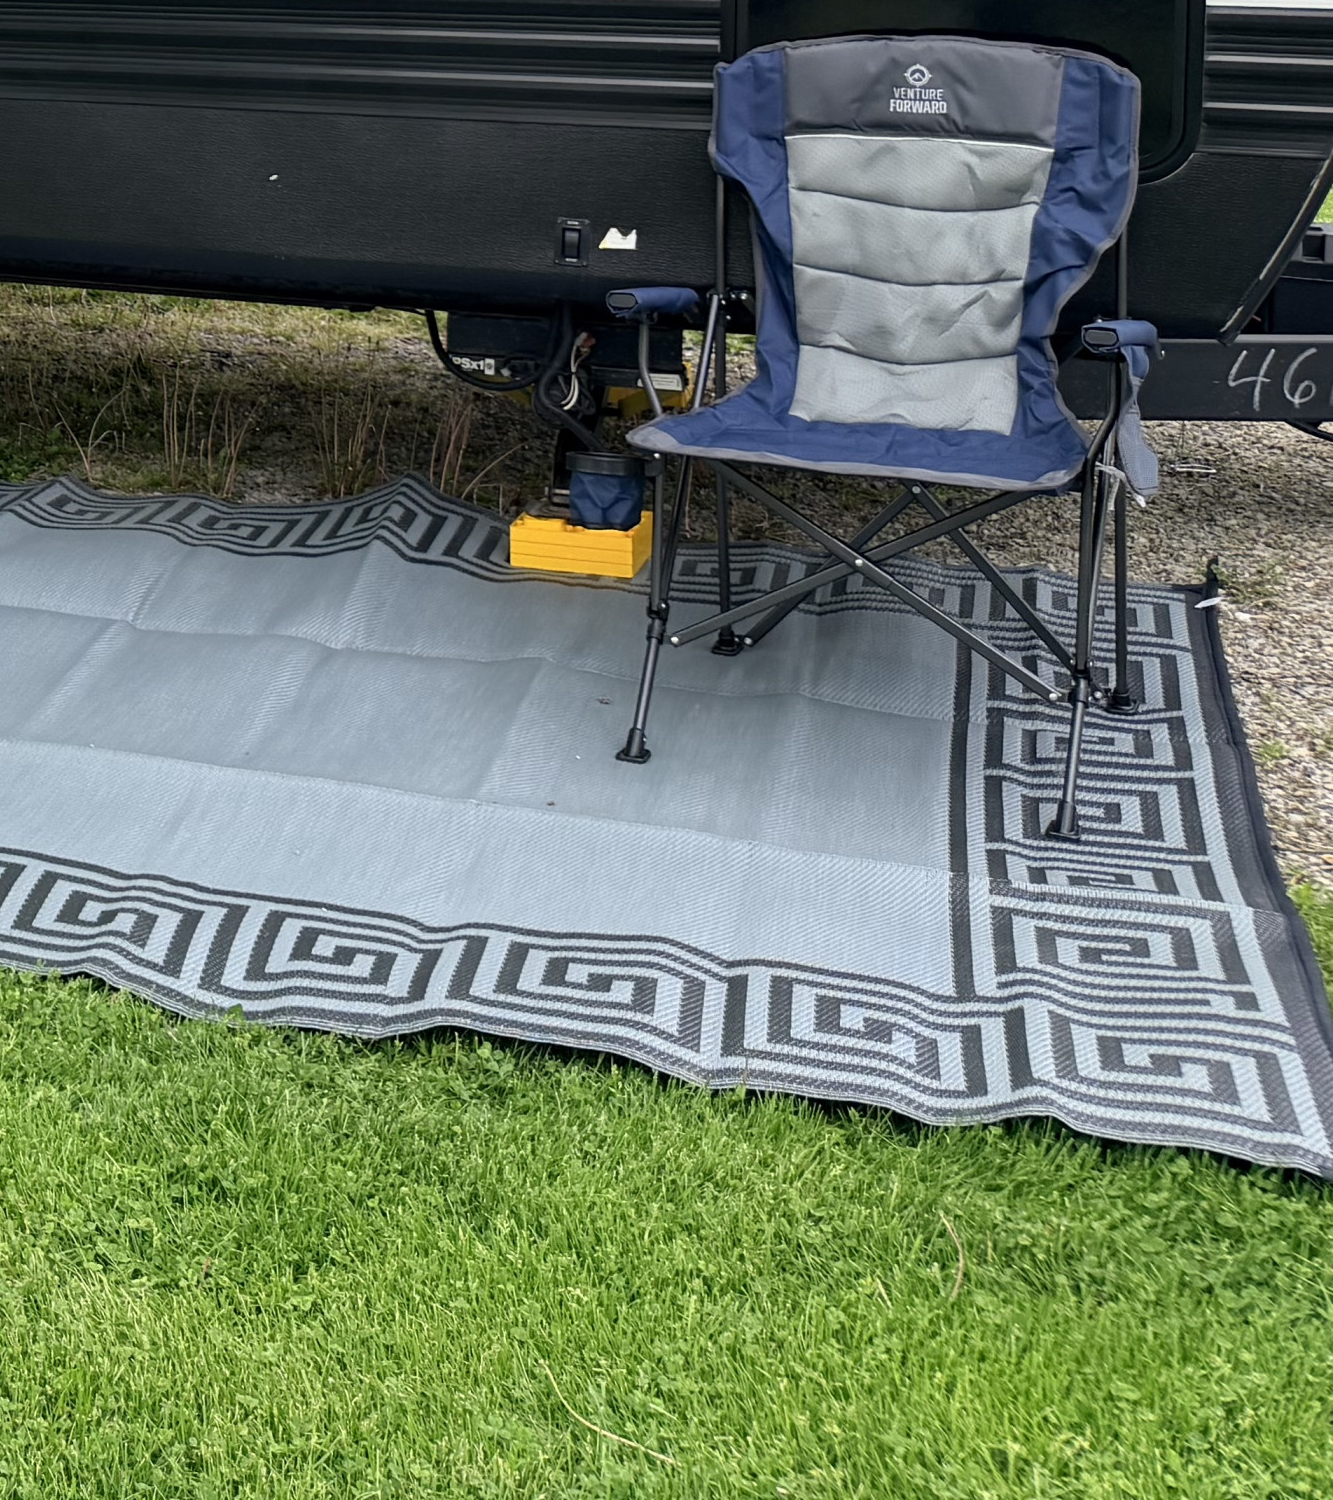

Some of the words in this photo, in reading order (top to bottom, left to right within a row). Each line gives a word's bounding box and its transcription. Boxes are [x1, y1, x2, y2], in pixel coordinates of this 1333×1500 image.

[893, 87, 945, 100] VENTURE
[889, 99, 948, 114] FORWARD
[1228, 347, 1333, 411] 46
